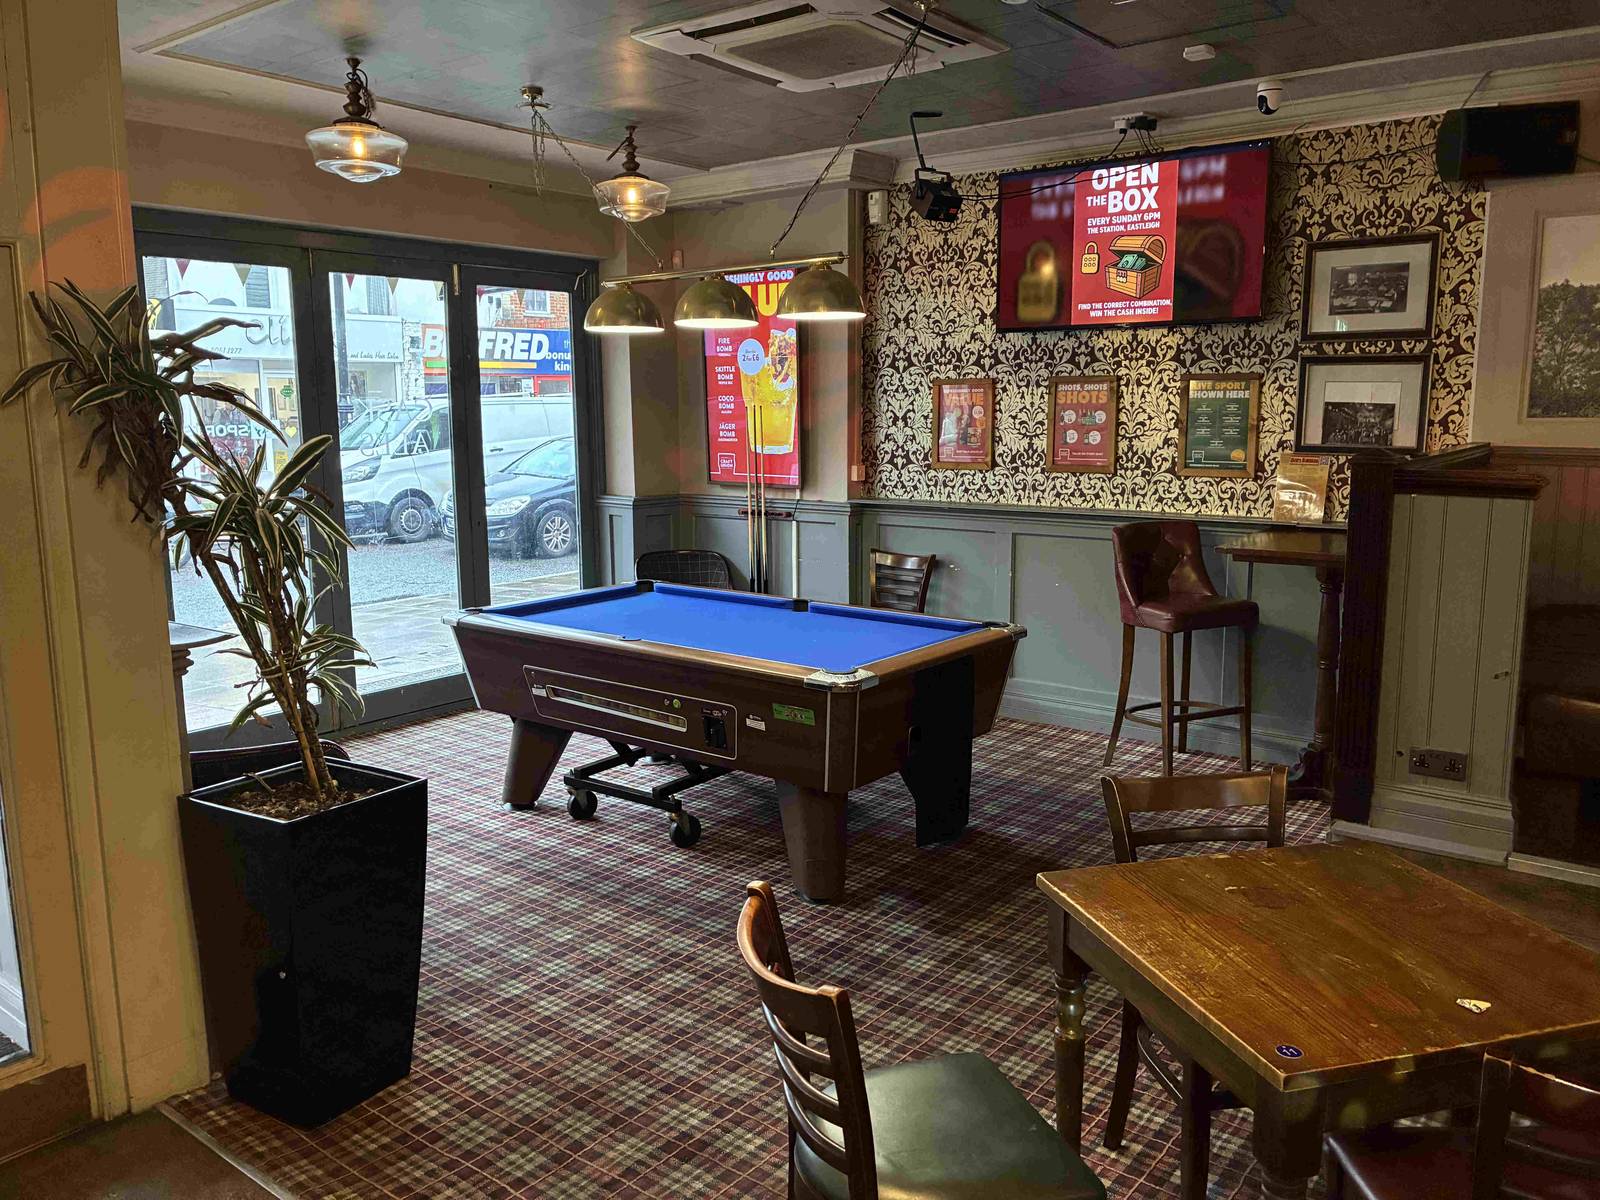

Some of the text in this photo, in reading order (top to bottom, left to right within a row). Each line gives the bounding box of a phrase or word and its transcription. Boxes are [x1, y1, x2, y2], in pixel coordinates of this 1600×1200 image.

[1092, 162, 1160, 191] OPEN
[1086, 195, 1107, 207] THE
[1107, 186, 1159, 213] BOX
[1087, 211, 1161, 227] EVERY SUNDAY 6PM
[1087, 221, 1160, 235] THE STATION, EASTLEIGH
[767, 270, 794, 281] GOOD
[1078, 299, 1172, 311] FIND THE CORRECT COMBINATION,
[1090, 307, 1158, 318] WIN THE CASH INSIDE!
[424, 329, 549, 360] BFRED
[546, 351, 570, 360] bonu
[554, 361, 570, 371] kin
[1084, 383, 1108, 391] SHOTS
[1215, 381, 1246, 389] SPORT
[1056, 391, 1108, 404] SHOTS
[1189, 390, 1251, 399] SHOWN HERE
[719, 422, 736, 430] JÄGER
